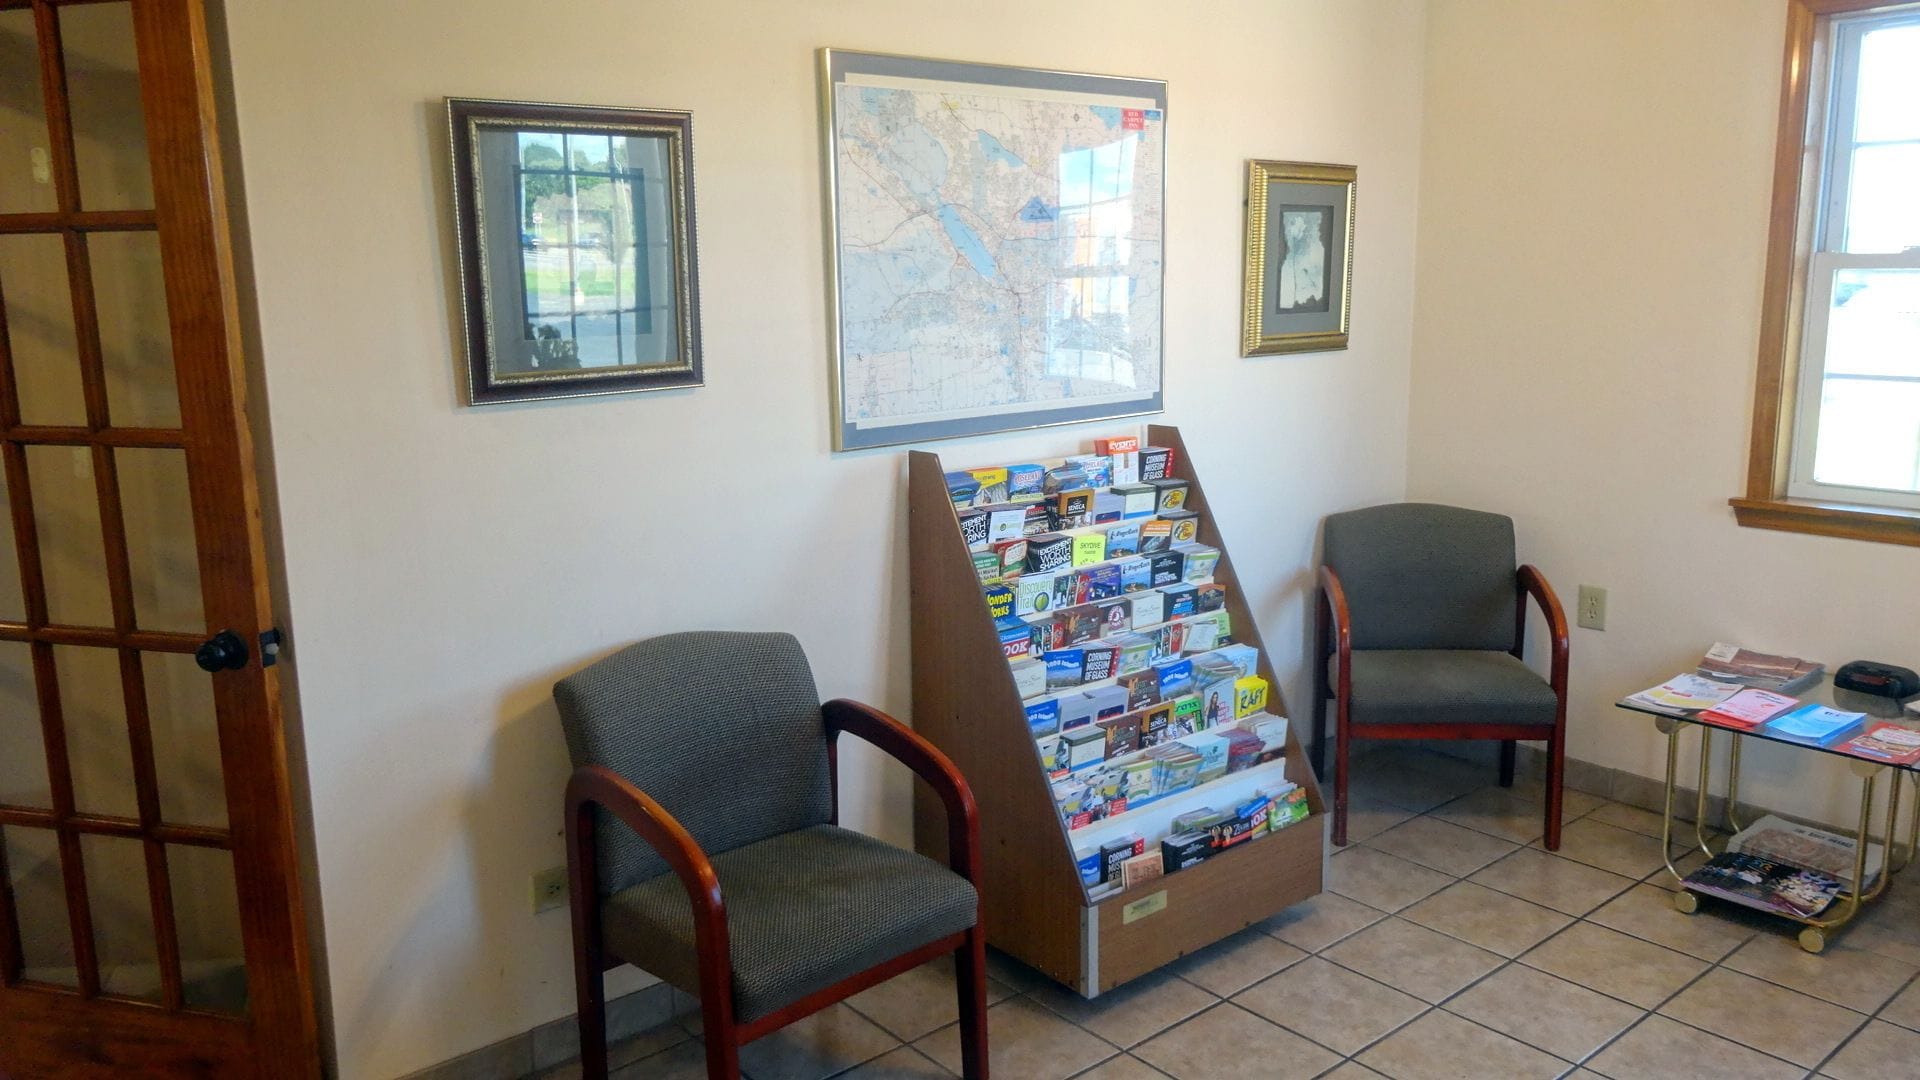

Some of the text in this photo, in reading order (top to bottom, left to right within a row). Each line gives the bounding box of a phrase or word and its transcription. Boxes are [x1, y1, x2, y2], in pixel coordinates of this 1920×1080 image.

[1111, 439, 1137, 451] EVENTS
[1146, 453, 1168, 465] CORNING
[1144, 462, 1166, 473] MUSEUM
[1150, 470, 1164, 480] GLASS
[1067, 503, 1086, 512] SENECA
[986, 593, 1013, 606] ONDER
[991, 605, 1010, 618] ORKS
[1088, 651, 1112, 663] CORNING
[1085, 660, 1110, 671] MUSEUM
[1093, 669, 1108, 680] GLASS
[1240, 688, 1266, 712] RAFT
[1108, 847, 1132, 864] CORNING
